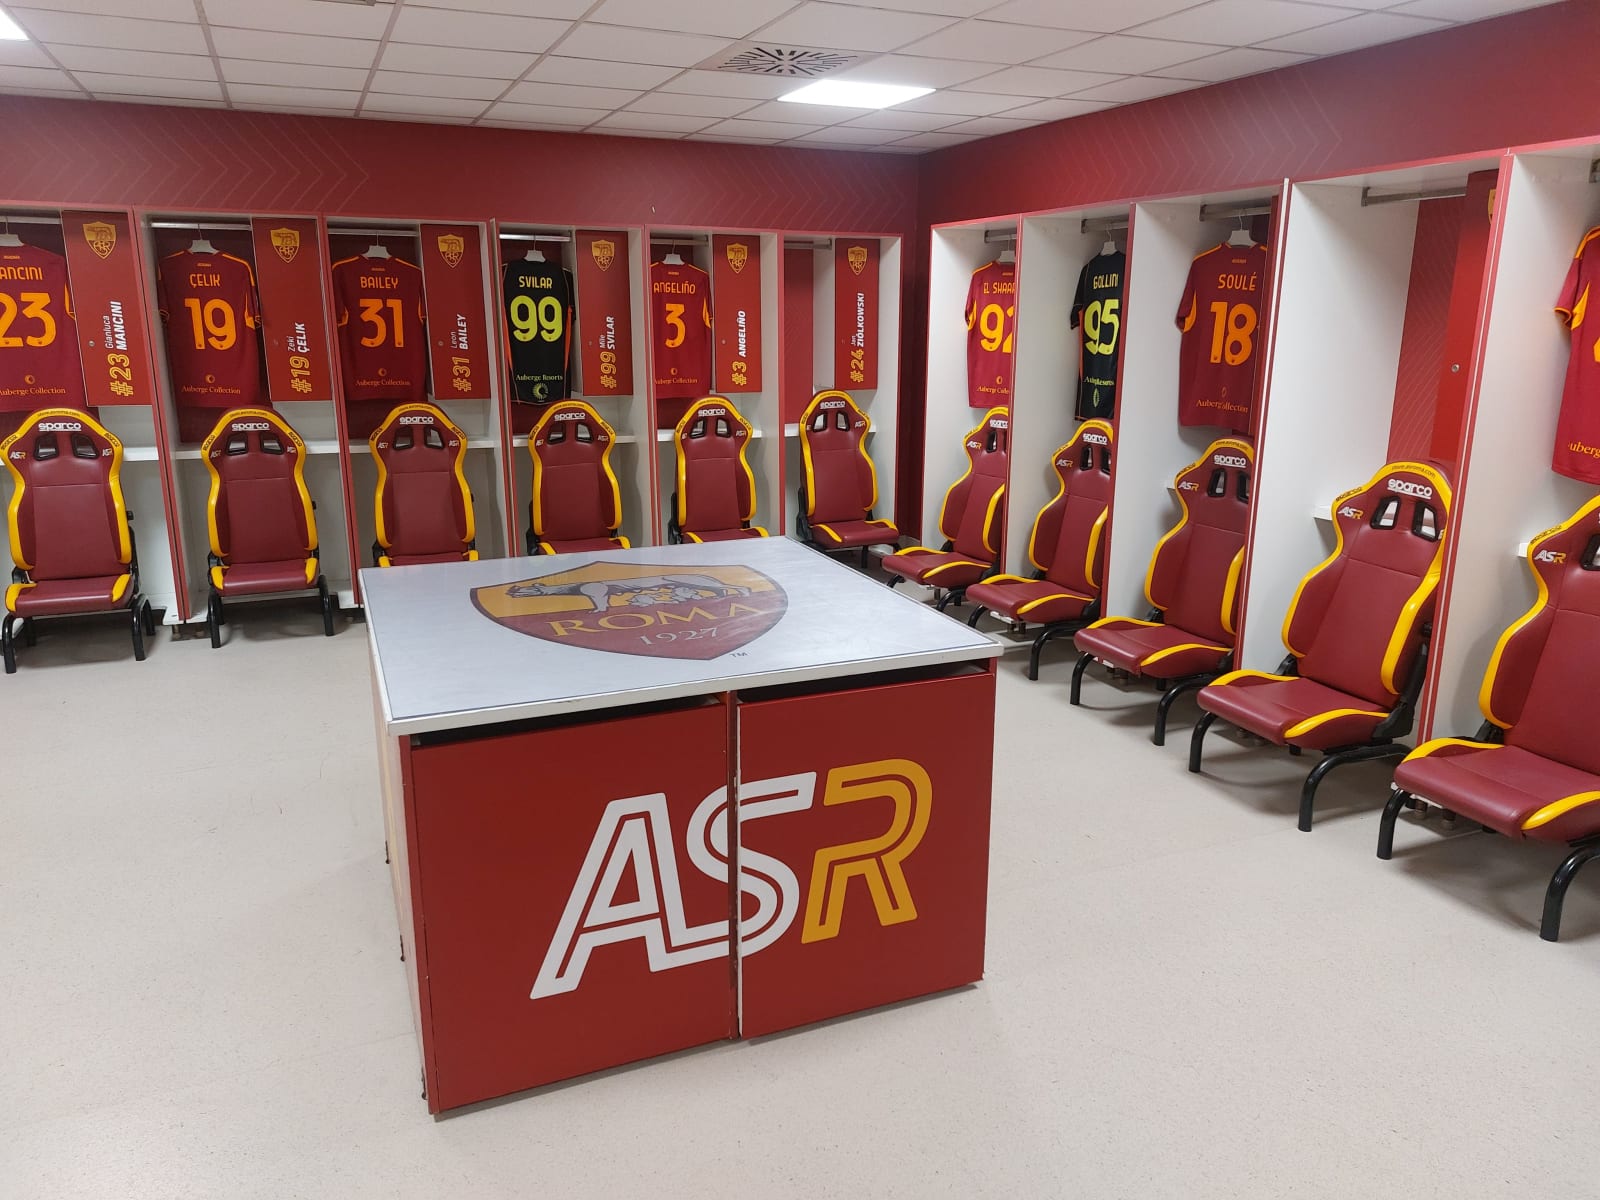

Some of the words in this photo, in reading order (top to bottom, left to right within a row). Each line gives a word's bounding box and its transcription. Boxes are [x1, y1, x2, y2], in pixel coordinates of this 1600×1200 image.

[0, 266, 43, 281] ANCINI
[189, 273, 221, 289] ÇELIK
[360, 276, 399, 289] BAILEY
[518, 275, 553, 289] SVILAR
[1093, 273, 1119, 290] GOLLINI
[1217, 272, 1257, 291] SOULÉ
[653, 280, 696, 295] ANGELIÑO
[0, 292, 57, 347] 23
[110, 301, 128, 350] MANCINI
[184, 298, 237, 350] 19
[359, 298, 404, 348] 31
[510, 295, 563, 342] 99
[665, 303, 686, 348] 3
[1084, 299, 1120, 355] 95
[103, 315, 114, 349] Gianluca
[295, 322, 311, 353] ÇELIK
[456, 314, 469, 350] BAILEY
[606, 316, 616, 350] SVILAR
[1210, 301, 1257, 366] 18
[287, 336, 296, 352] Zeki
[107, 353, 134, 397] #23
[289, 355, 313, 394] #19
[452, 356, 472, 392] #31
[600, 351, 617, 389] #99
[731, 361, 747, 386] #3
[850, 349, 865, 383] #24
[516, 374, 542, 382] Auberge
[181, 386, 208, 394] Auberge
[697, 408, 726, 417] sparco
[1196, 400, 1221, 409] Auber
[38, 422, 82, 432] sparco
[231, 422, 270, 431] sparco
[399, 416, 434, 425] sparco
[966, 440, 982, 449] ASR
[1569, 441, 1600, 458] uberg
[9, 451, 26, 459] ASR
[1055, 459, 1074, 468] ASR
[1213, 454, 1247, 468] sparco
[1178, 481, 1200, 491] ASR
[1387, 478, 1432, 500] sparco
[1337, 506, 1364, 519] ASR
[1534, 549, 1567, 564] ASR
[546, 602, 762, 637] ROMA
[639, 626, 719, 646] 1927
[530, 758, 933, 1000] ASR
